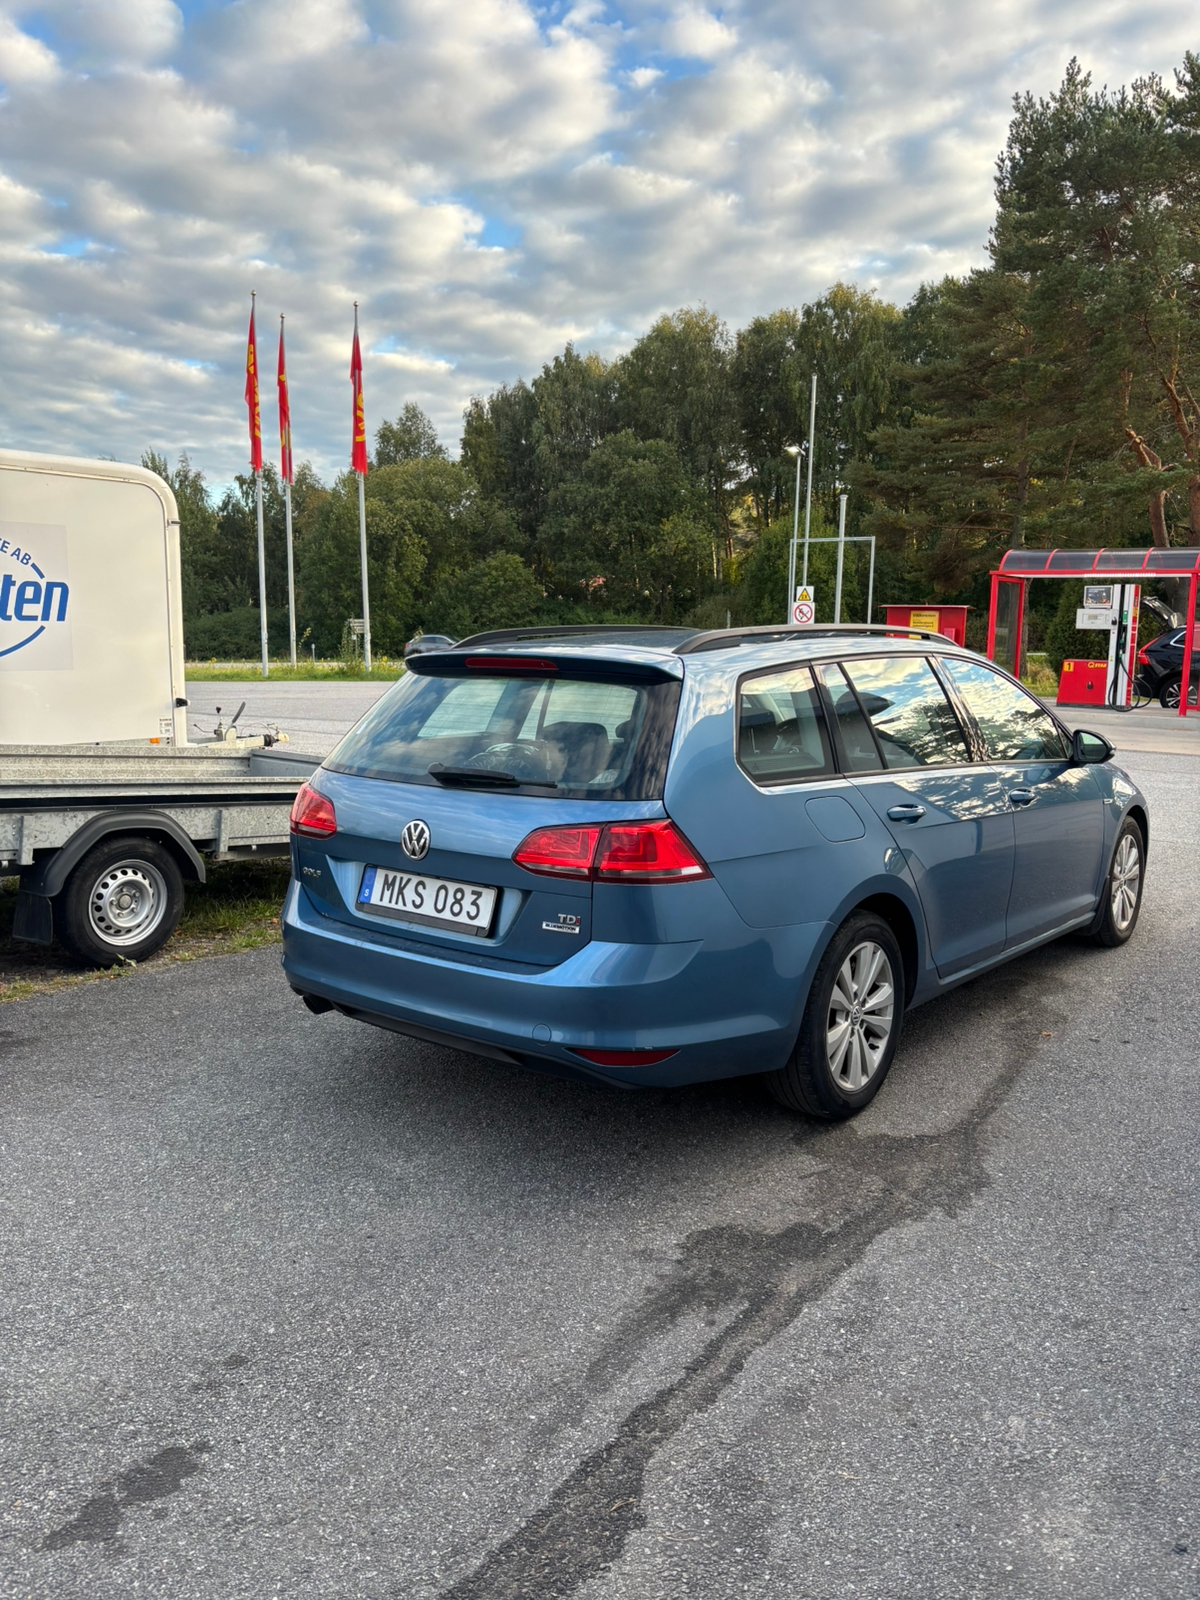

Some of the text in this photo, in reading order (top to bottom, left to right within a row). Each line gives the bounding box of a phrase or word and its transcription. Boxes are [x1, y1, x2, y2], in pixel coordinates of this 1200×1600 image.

[0, 538, 32, 566] E AB
[364, 888, 370, 897] S
[379, 873, 483, 921] MKS 083
